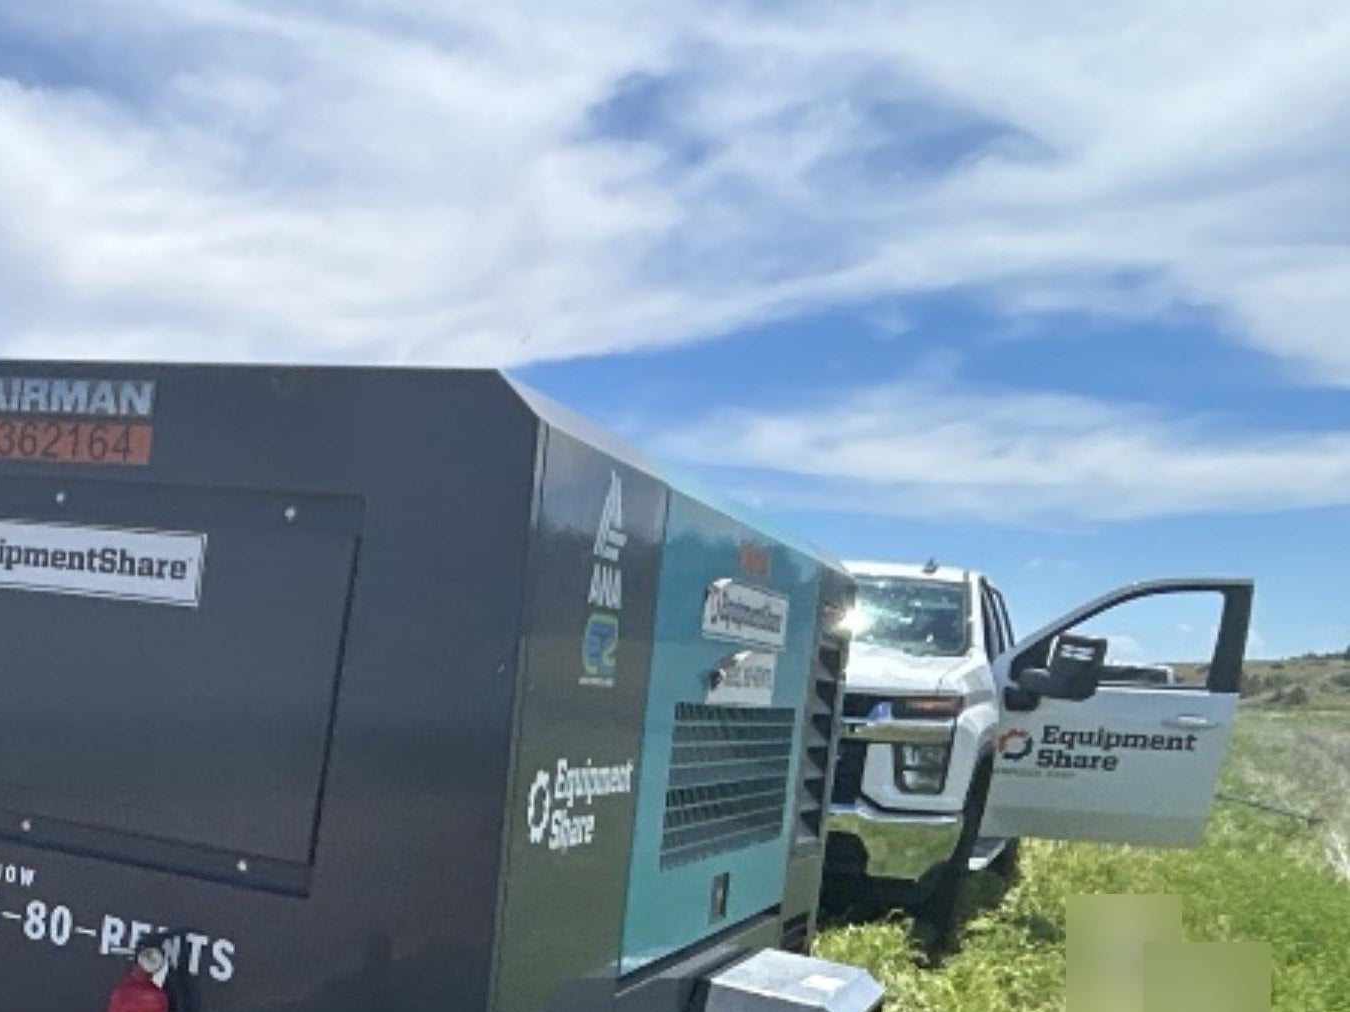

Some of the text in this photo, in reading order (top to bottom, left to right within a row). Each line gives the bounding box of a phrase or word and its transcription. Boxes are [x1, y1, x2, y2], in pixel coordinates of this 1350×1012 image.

[1040, 725, 1198, 751] Equipment
[1036, 749, 1120, 771] Share
[554, 758, 634, 808] Equipment
[548, 809, 595, 852] Share
